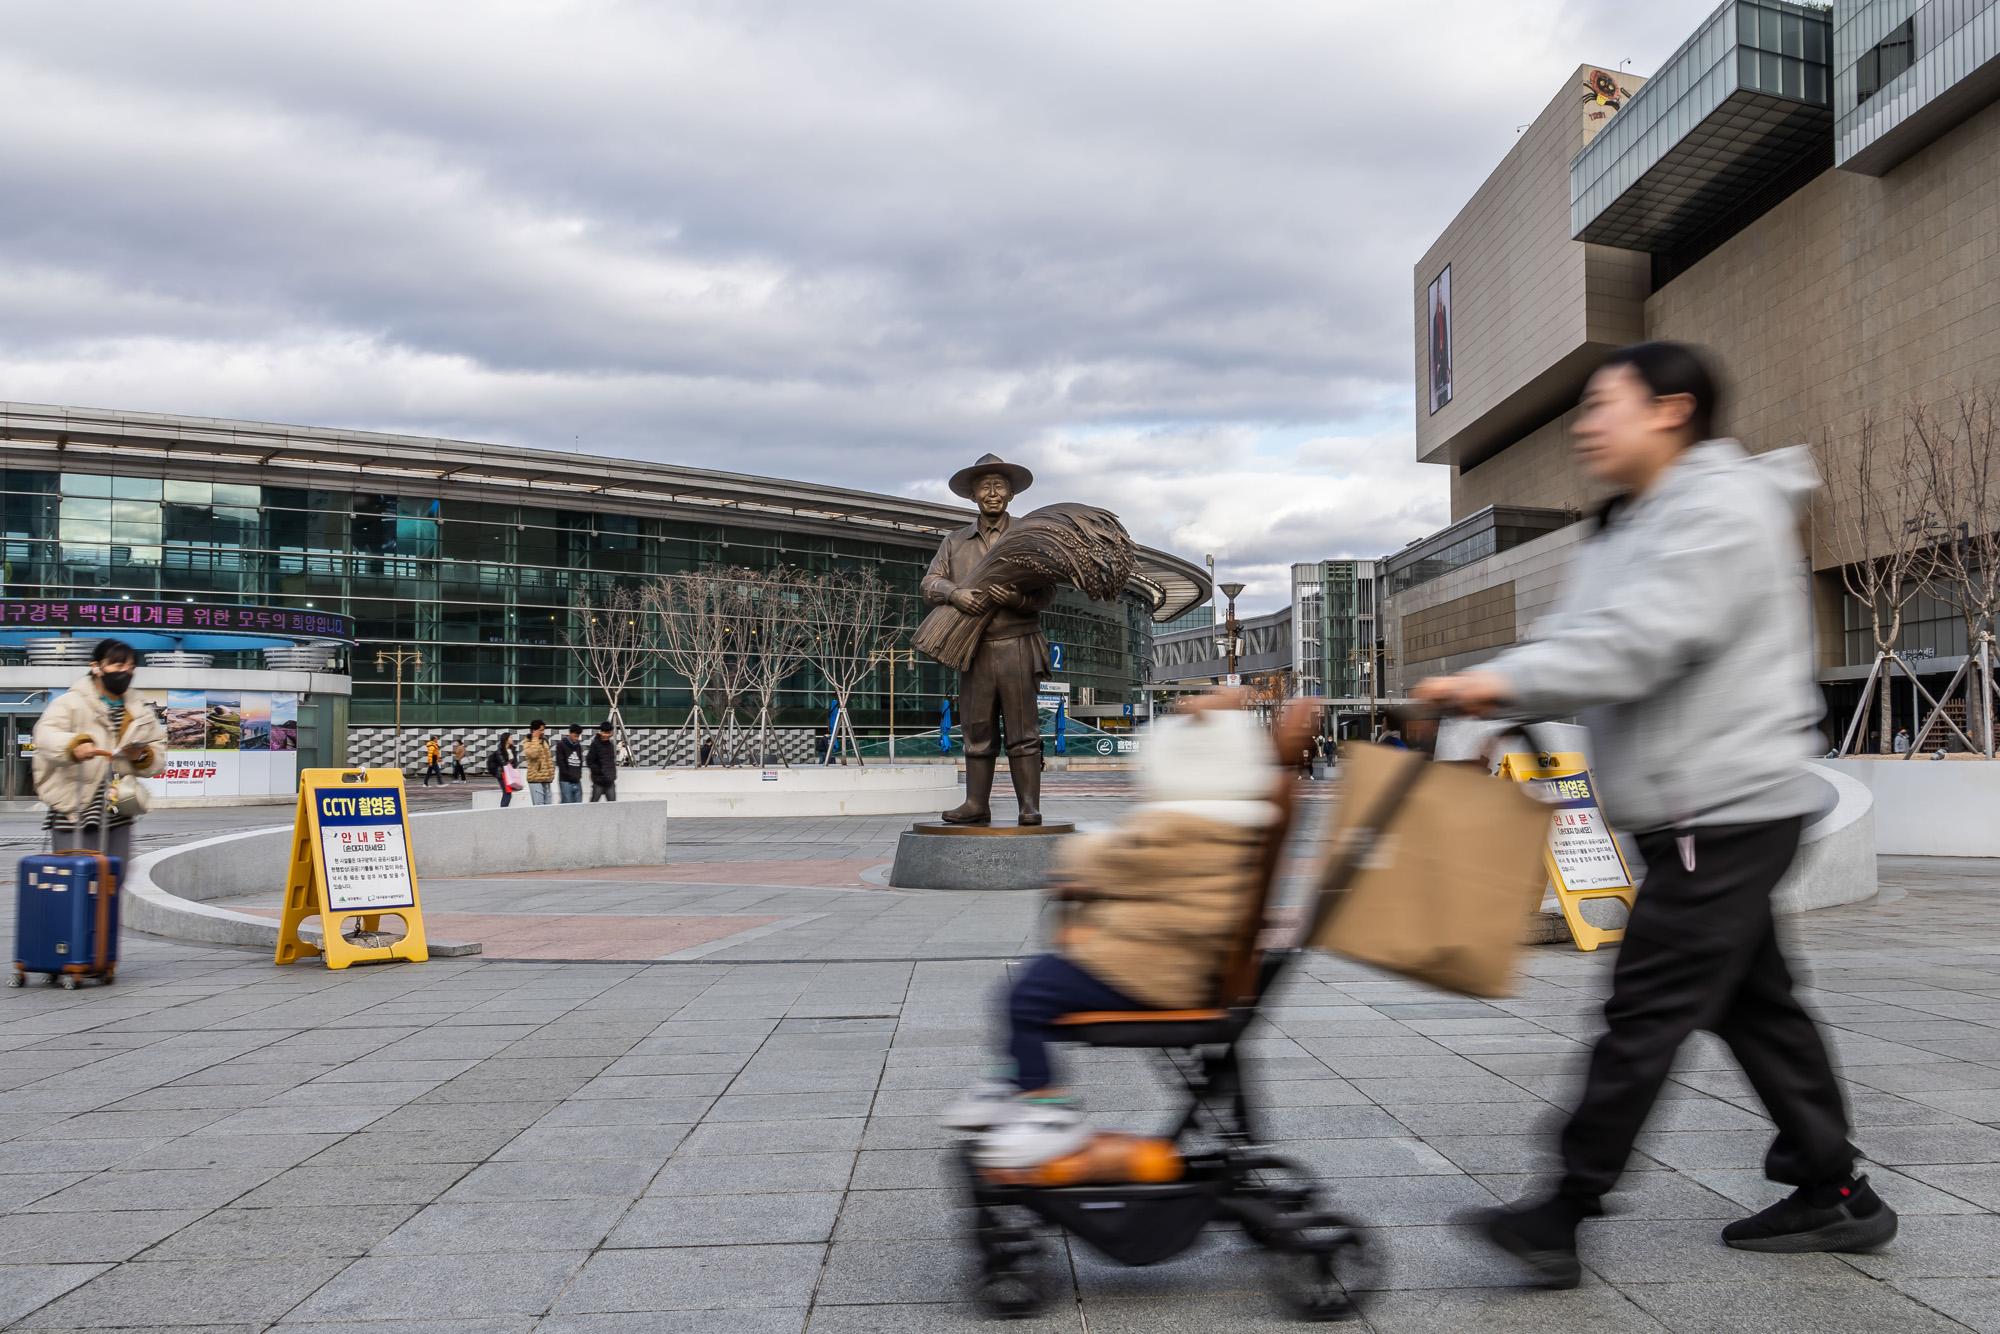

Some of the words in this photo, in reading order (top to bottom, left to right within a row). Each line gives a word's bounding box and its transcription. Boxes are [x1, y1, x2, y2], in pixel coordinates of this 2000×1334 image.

[79, 604, 184, 624] 백년대계를
[193, 608, 231, 627] 위한
[238, 611, 286, 630] 모두의
[292, 614, 345, 635] 희망입니다.
[1053, 645, 1061, 668] 2
[1125, 705, 1131, 715] 2
[192, 768, 217, 779] 대구
[1557, 780, 1591, 799] 촬영중
[322, 797, 356, 816] CCTV
[358, 796, 396, 816] 촬영중
